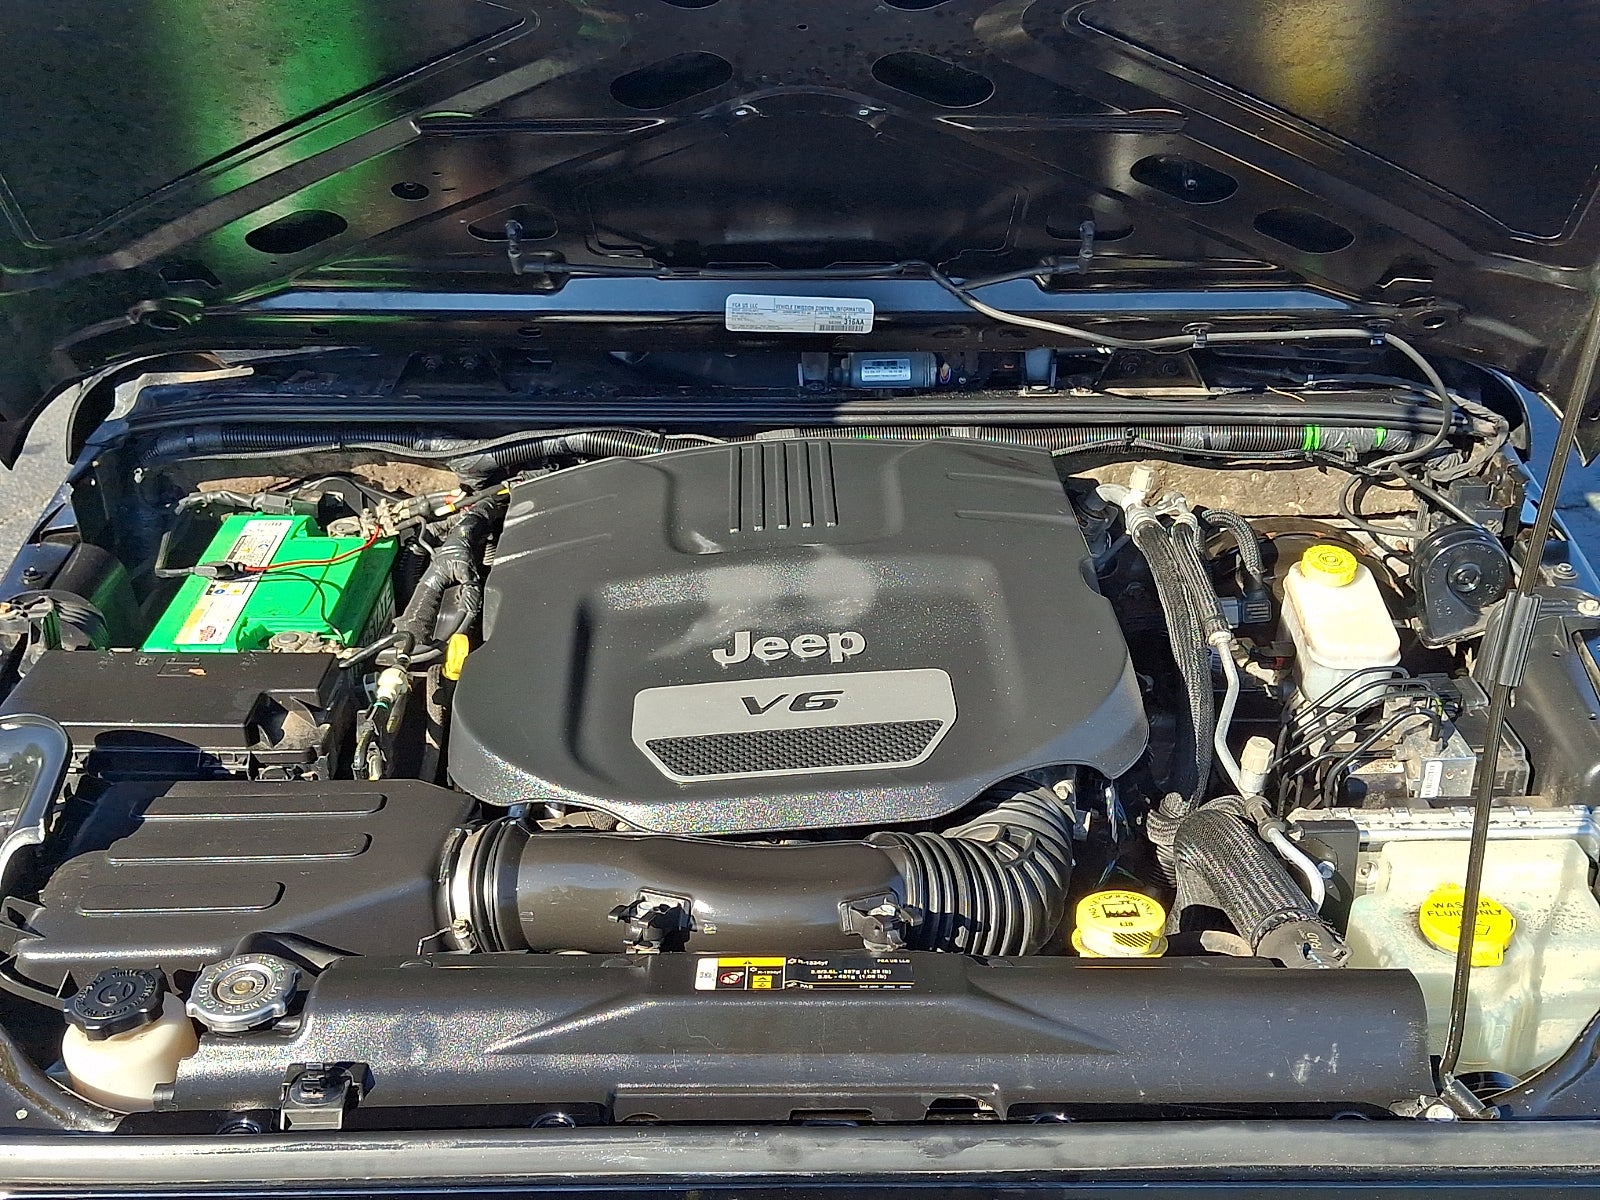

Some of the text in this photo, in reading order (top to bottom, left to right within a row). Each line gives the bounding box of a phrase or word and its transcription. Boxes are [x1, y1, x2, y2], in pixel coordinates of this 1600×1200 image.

[712, 630, 867, 665] Jeep
[741, 690, 845, 716] V6
[1432, 901, 1490, 909] WASR
[1474, 909, 1502, 917] NLY
[1306, 932, 1322, 950] RAD
[216, 956, 250, 973] KEEP
[224, 1001, 260, 1014] OPEN
